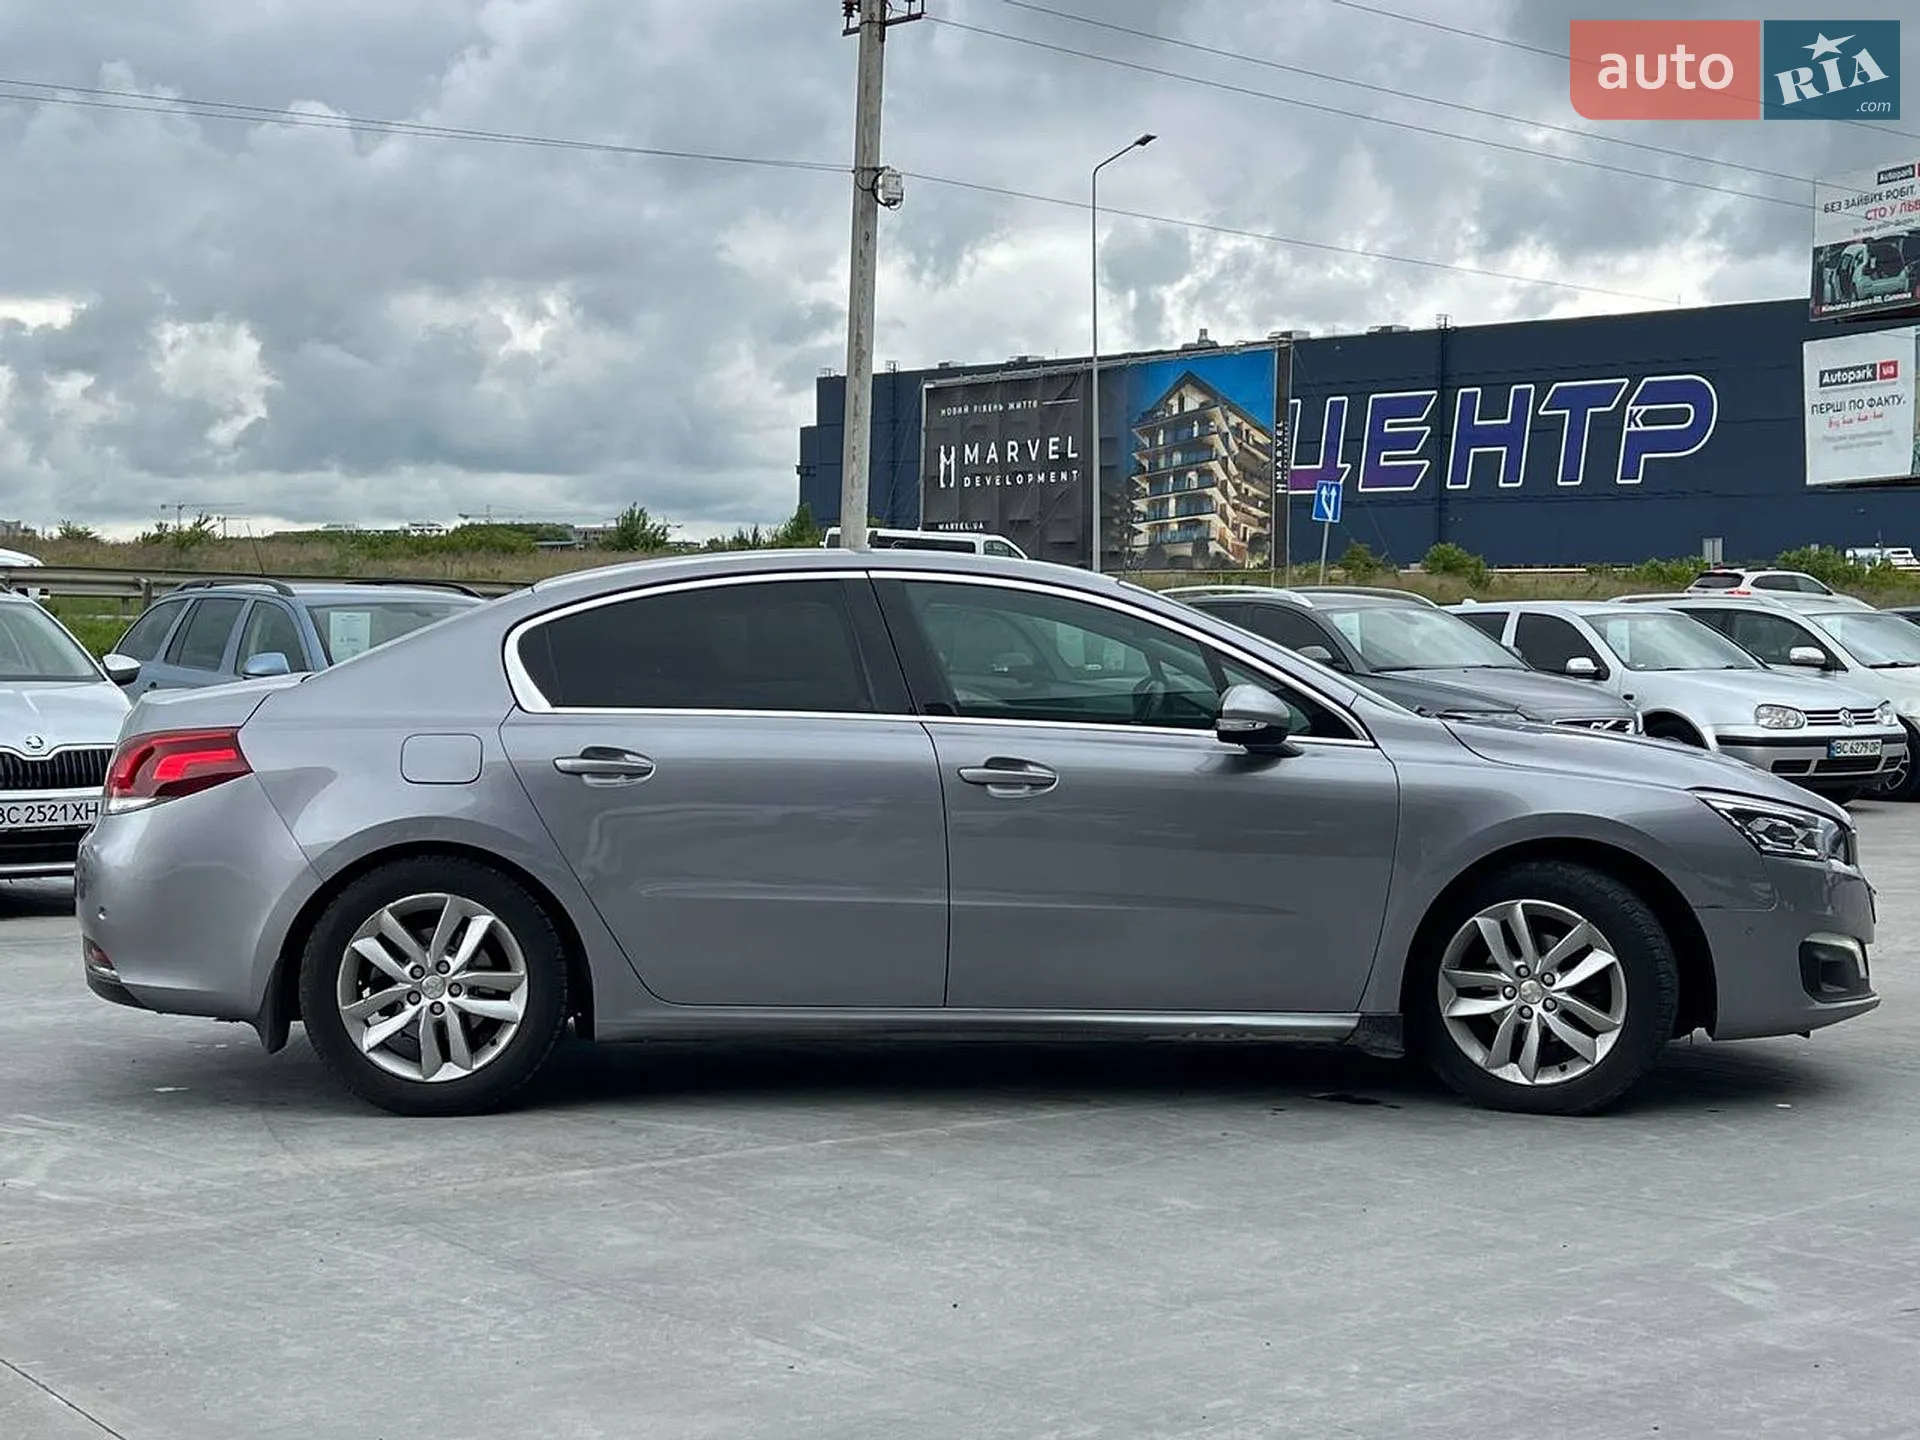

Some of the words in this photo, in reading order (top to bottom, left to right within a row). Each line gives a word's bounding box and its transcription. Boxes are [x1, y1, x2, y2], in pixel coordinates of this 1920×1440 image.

[1823, 201, 1842, 214] БЕЗ
[1865, 206, 1887, 221] СТО
[1822, 365, 1874, 384] Autopark
[1811, 400, 1847, 415] ПЕРШІ
[1849, 398, 1865, 410] ПО
[1289, 374, 1718, 494] ЦЕНТР
[963, 435, 1079, 465] MARVEL
[963, 469, 1079, 488] DEVELOPMENT
[25, 803, 68, 824] 2521
[71, 801, 99, 821] XH
